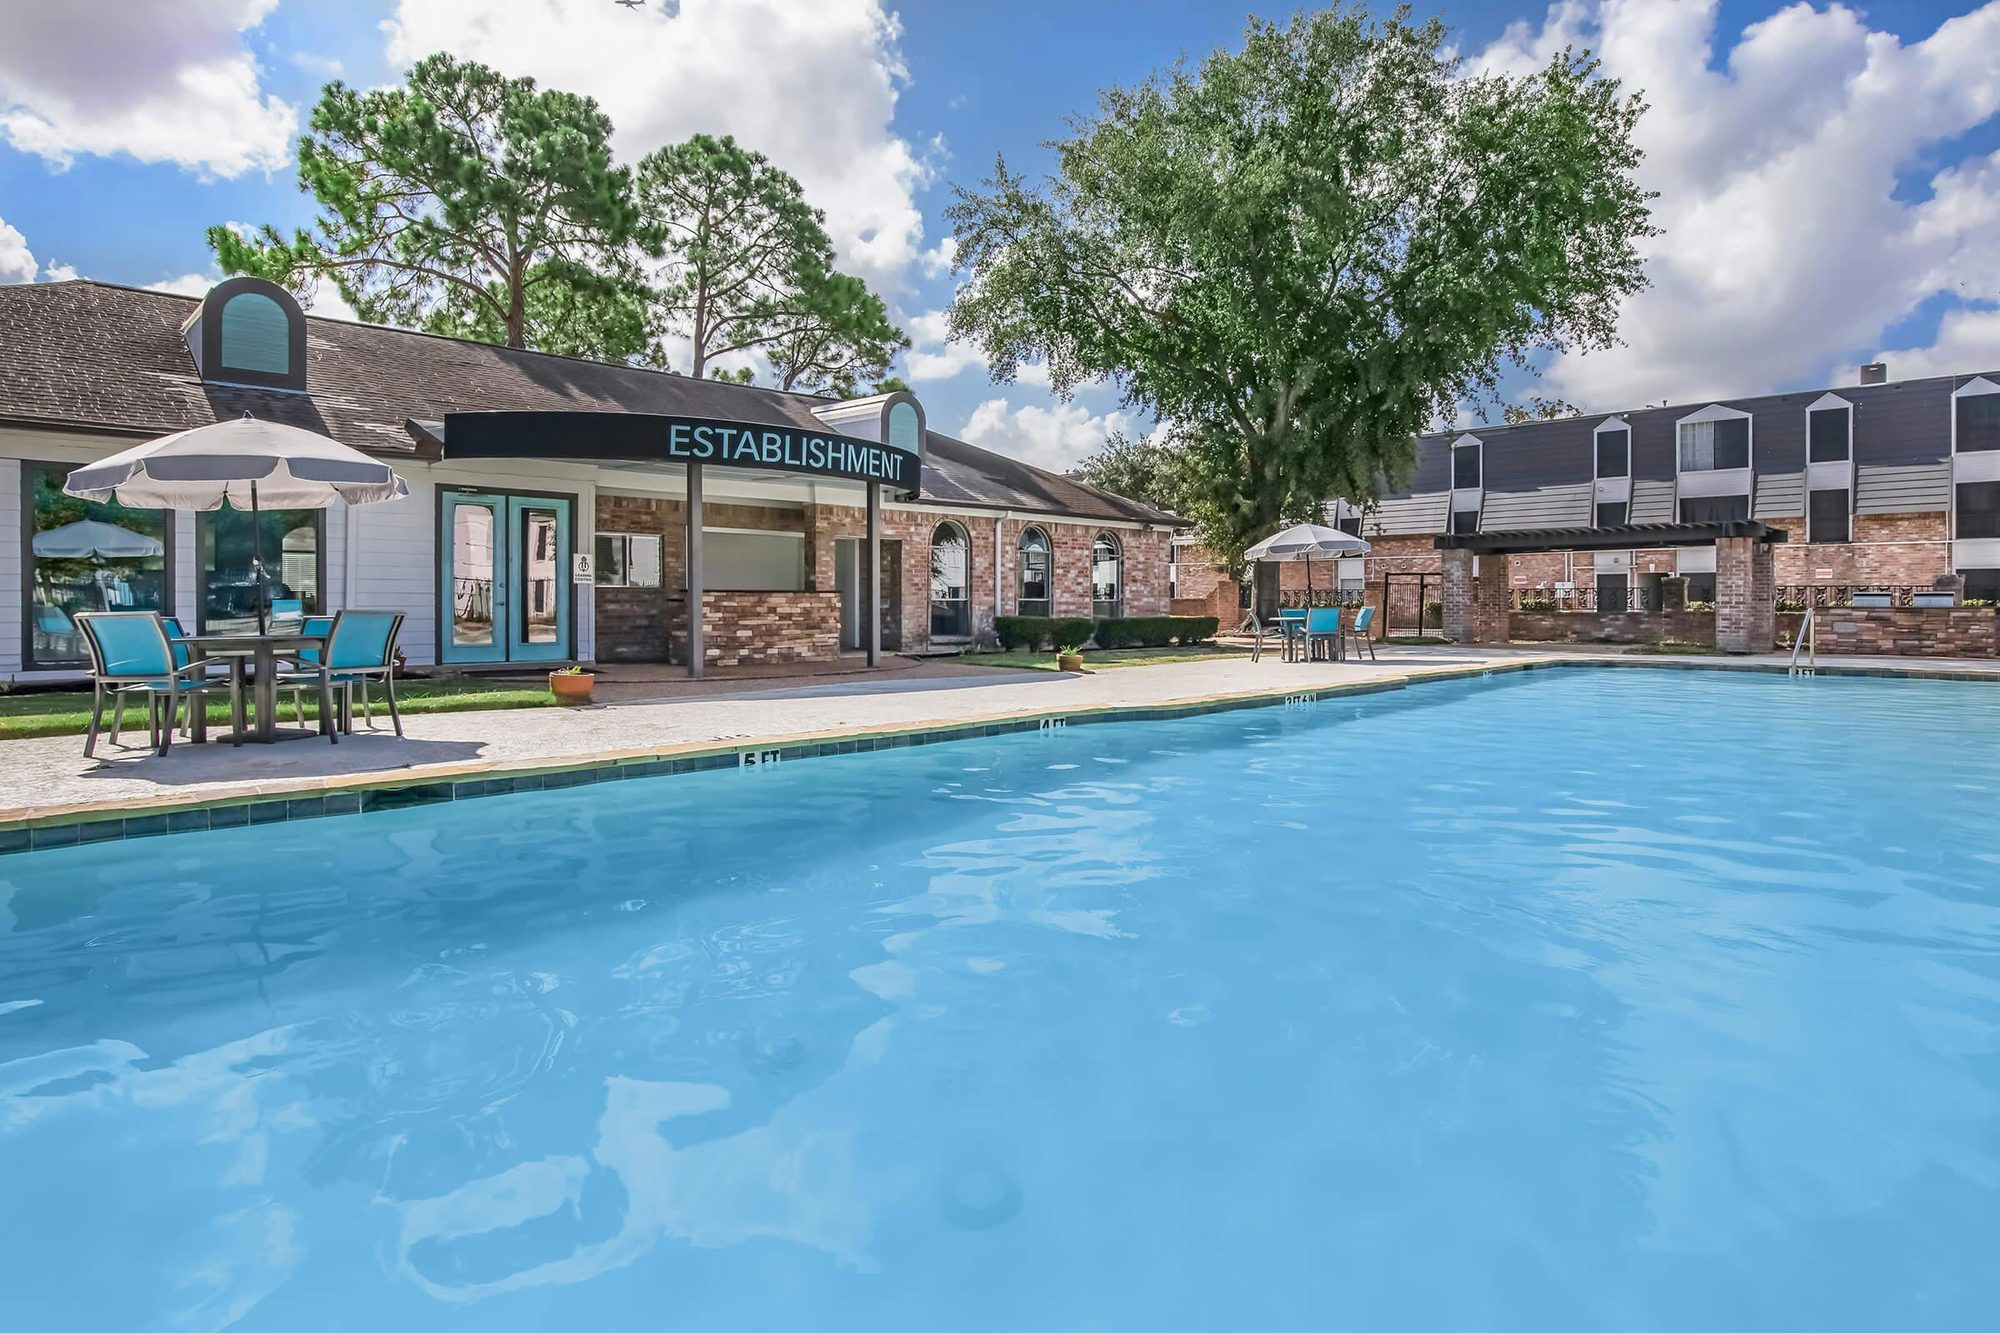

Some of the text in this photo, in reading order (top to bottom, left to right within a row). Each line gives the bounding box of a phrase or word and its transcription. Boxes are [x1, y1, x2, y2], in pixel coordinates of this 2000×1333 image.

[669, 424, 903, 481] ESTABLISHMENT
[744, 749, 780, 766] 5 FT
